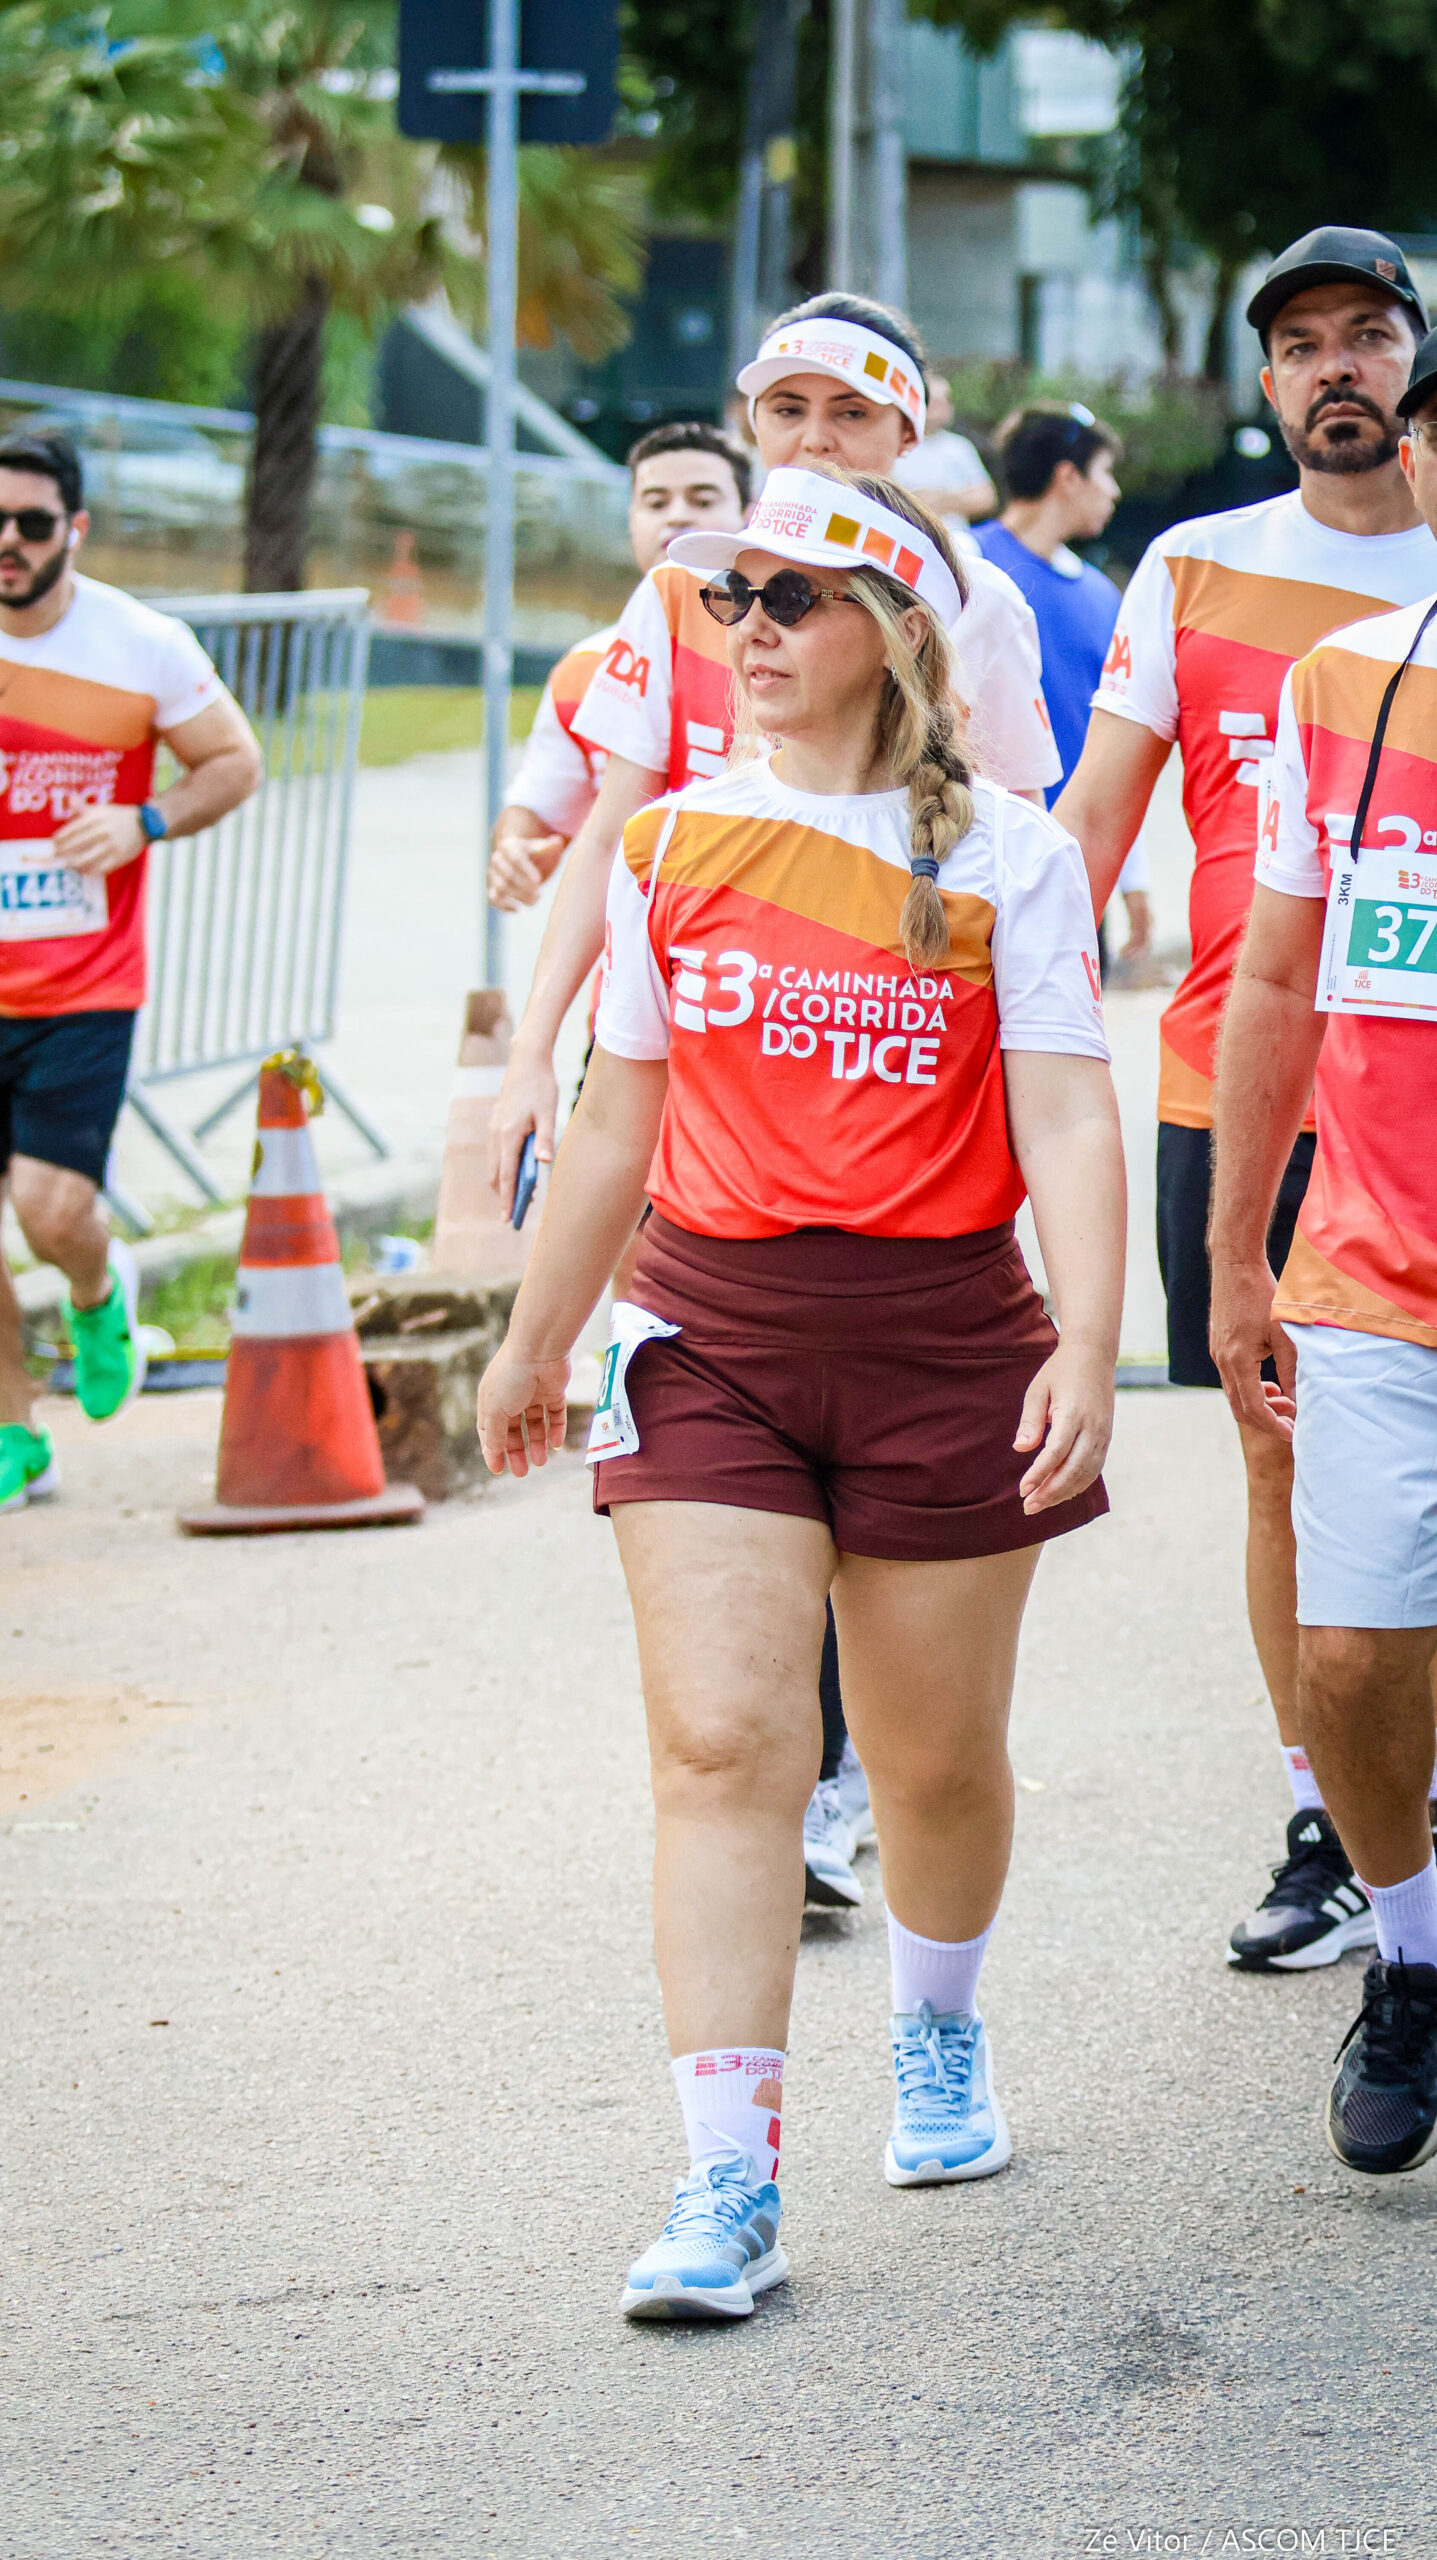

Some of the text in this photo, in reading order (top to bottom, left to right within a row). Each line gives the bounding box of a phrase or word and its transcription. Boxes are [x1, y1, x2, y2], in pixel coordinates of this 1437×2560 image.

[773, 519, 809, 539] TJCE
[1337, 873, 1353, 906] 3KM
[779, 966, 954, 1000] CAMINHADA
[1354, 979, 1372, 989] TJCE
[762, 1021, 941, 1085] DO TJCE
